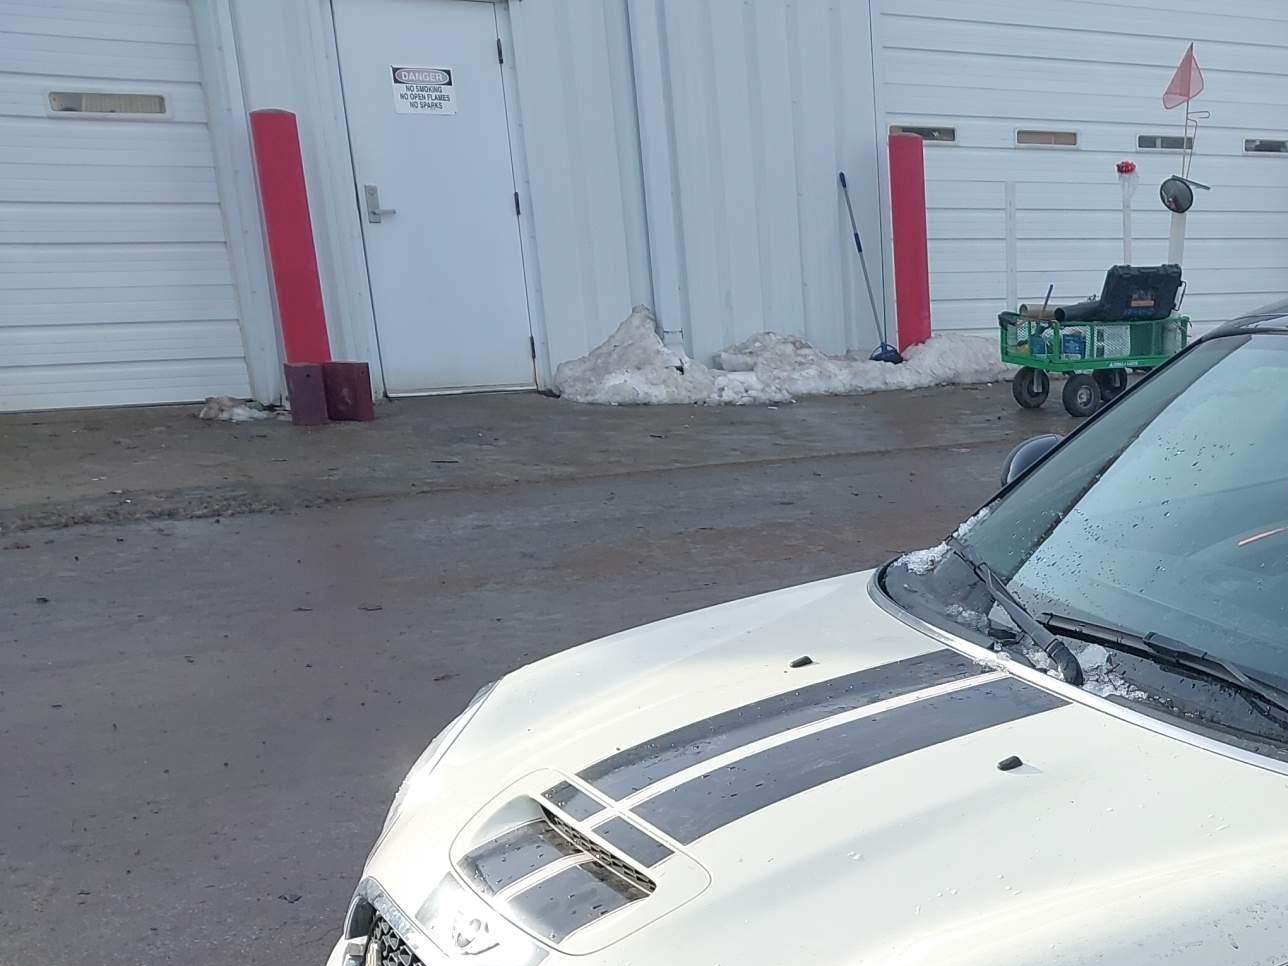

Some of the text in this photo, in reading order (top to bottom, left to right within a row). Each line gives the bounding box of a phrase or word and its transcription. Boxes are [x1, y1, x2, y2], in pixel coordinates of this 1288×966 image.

[401, 71, 443, 81] DANGER
[405, 85, 443, 93] NO SMOKING
[399, 93, 451, 102] NO OPEN FLAMES
[409, 101, 443, 109] NO SPARKS
